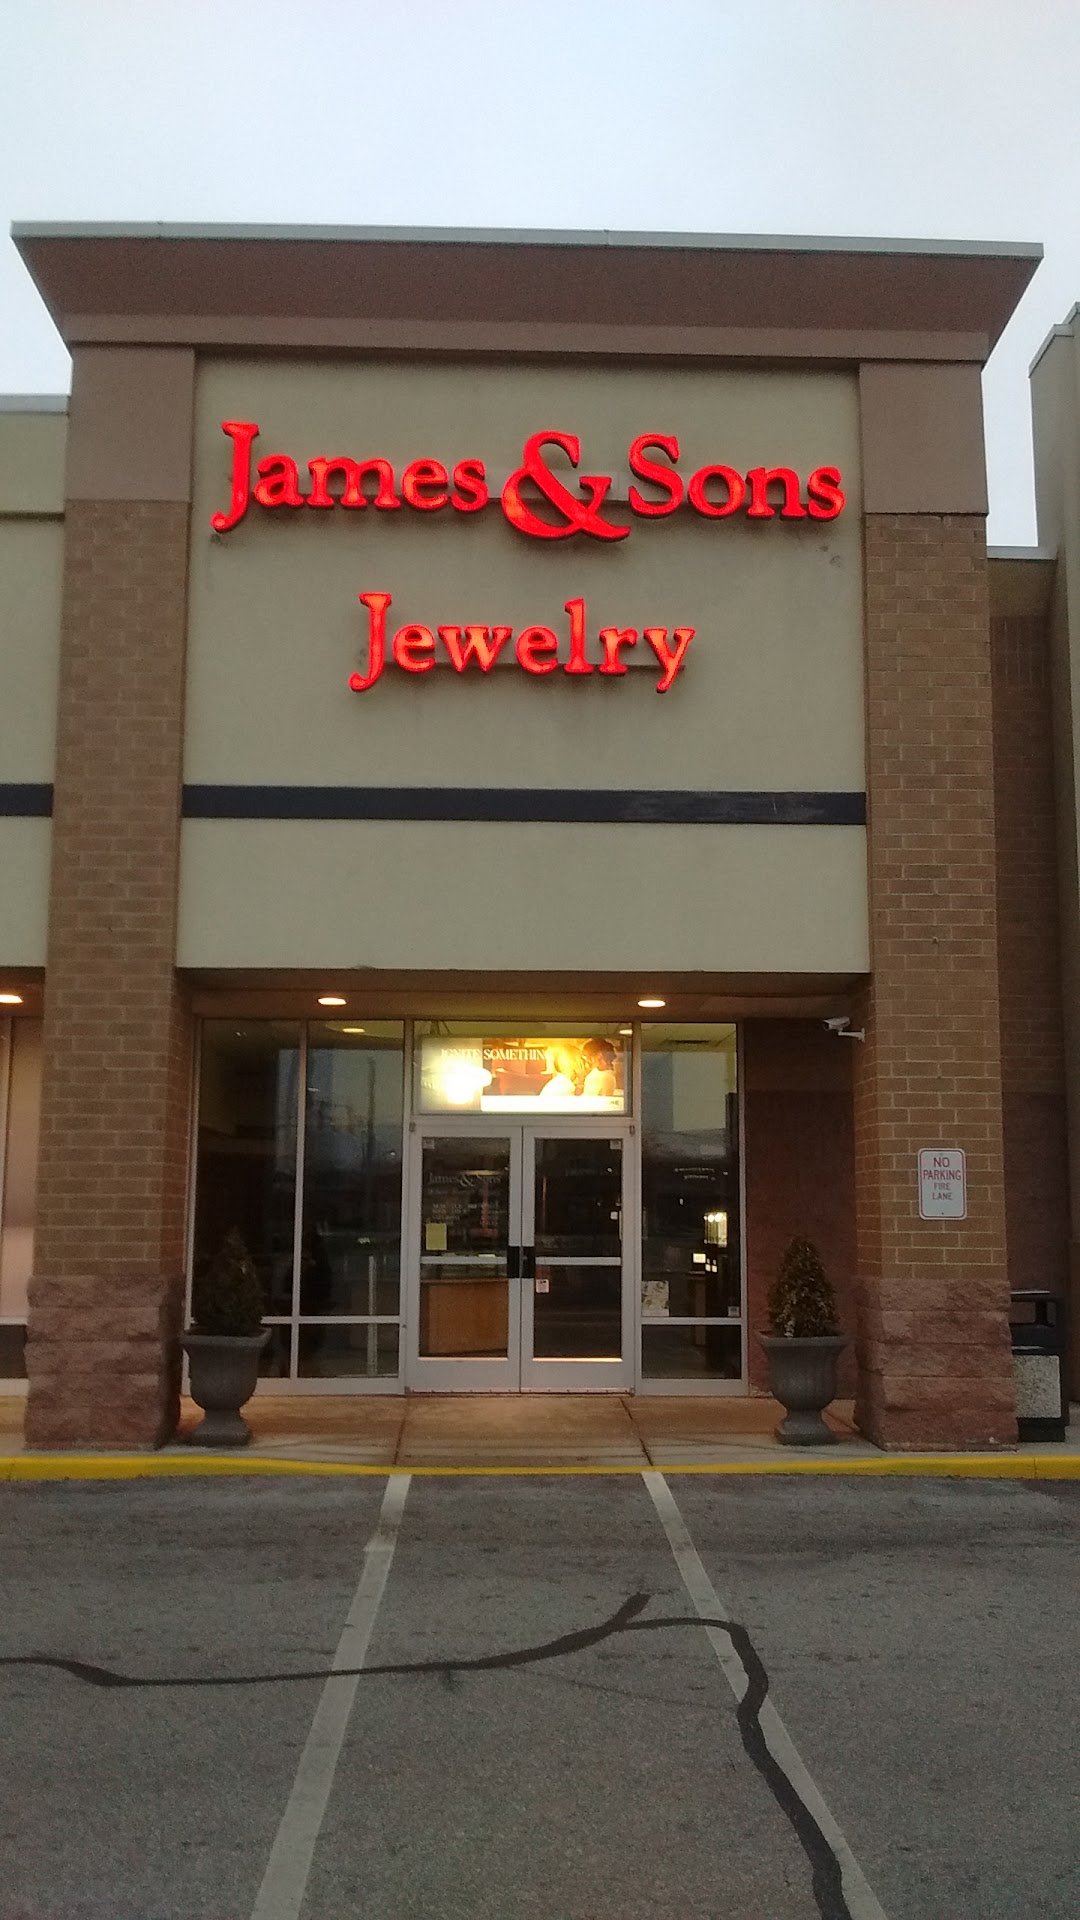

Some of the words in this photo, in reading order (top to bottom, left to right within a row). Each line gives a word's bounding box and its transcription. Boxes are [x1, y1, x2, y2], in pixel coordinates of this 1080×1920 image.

[210, 421, 490, 533] James
[501, 430, 631, 541] &
[628, 433, 846, 520] Sons
[349, 592, 696, 693] Jewelry
[933, 1157, 950, 1168] NO
[923, 1169, 962, 1181] PARKING
[934, 1182, 951, 1191] FIRE
[932, 1192, 953, 1200] LANE
